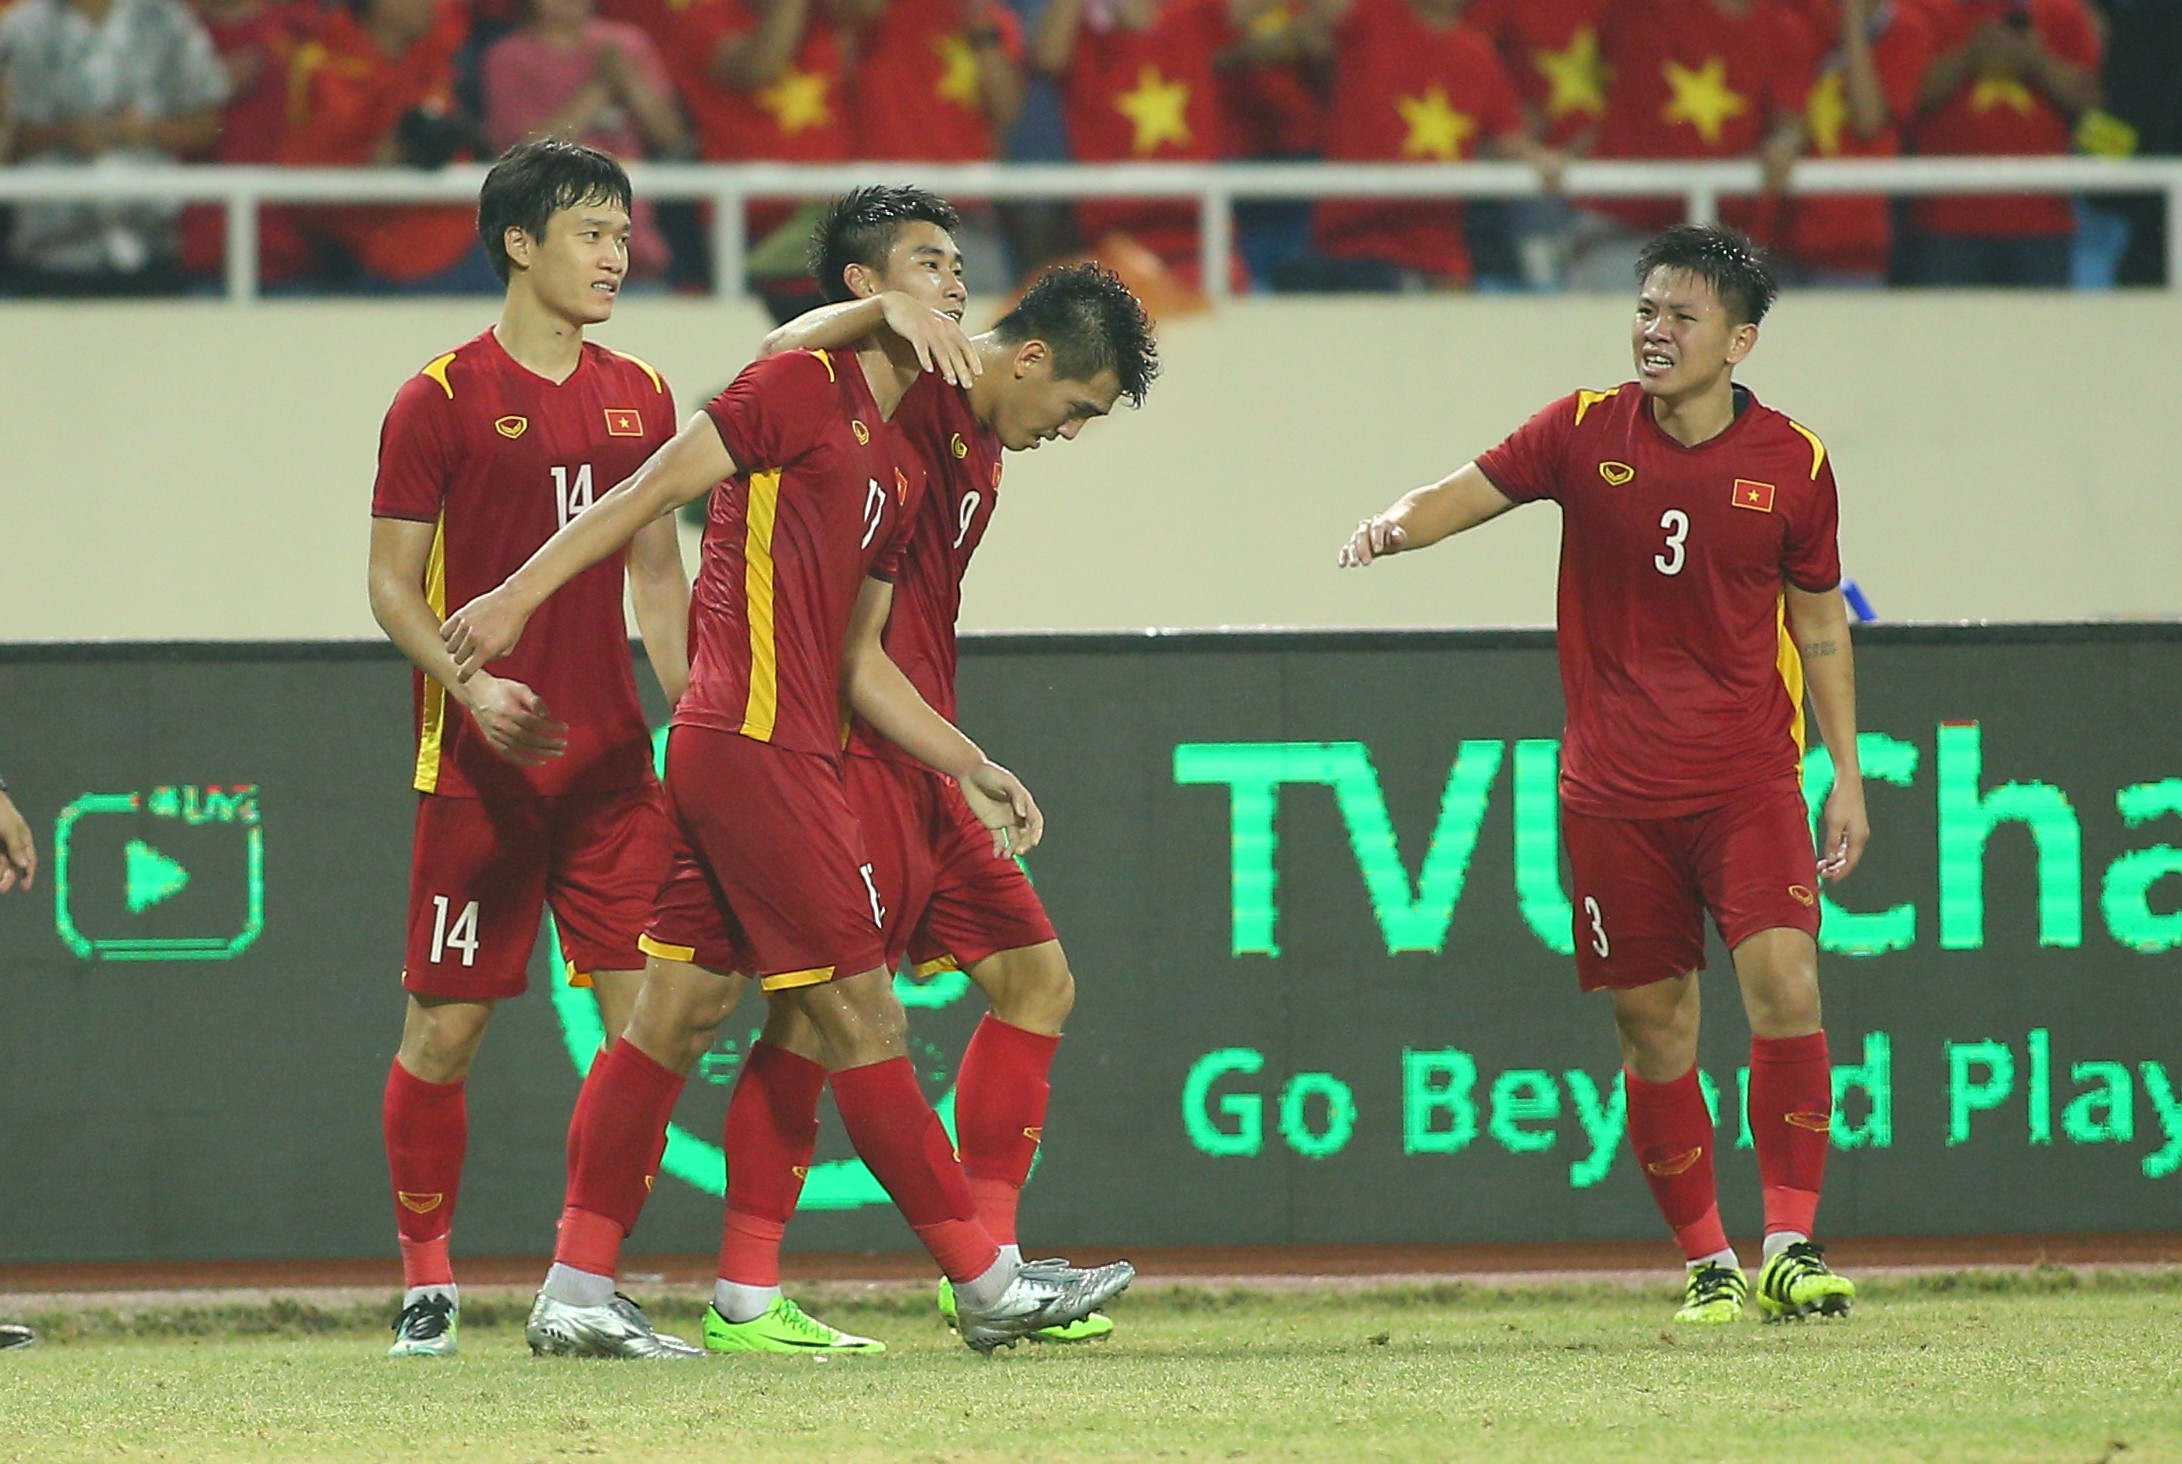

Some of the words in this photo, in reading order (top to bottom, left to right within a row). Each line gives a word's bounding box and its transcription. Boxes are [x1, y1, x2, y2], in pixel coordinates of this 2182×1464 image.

[550, 464, 593, 528] 14
[953, 490, 980, 549] 9
[1655, 509, 1690, 576] 3
[429, 895, 479, 966] 14
[1585, 896, 1610, 957] 3
[1182, 1048, 1355, 1158] Go
[1403, 1031, 1892, 1187] Beyd
[1945, 1028, 2182, 1178] Play
